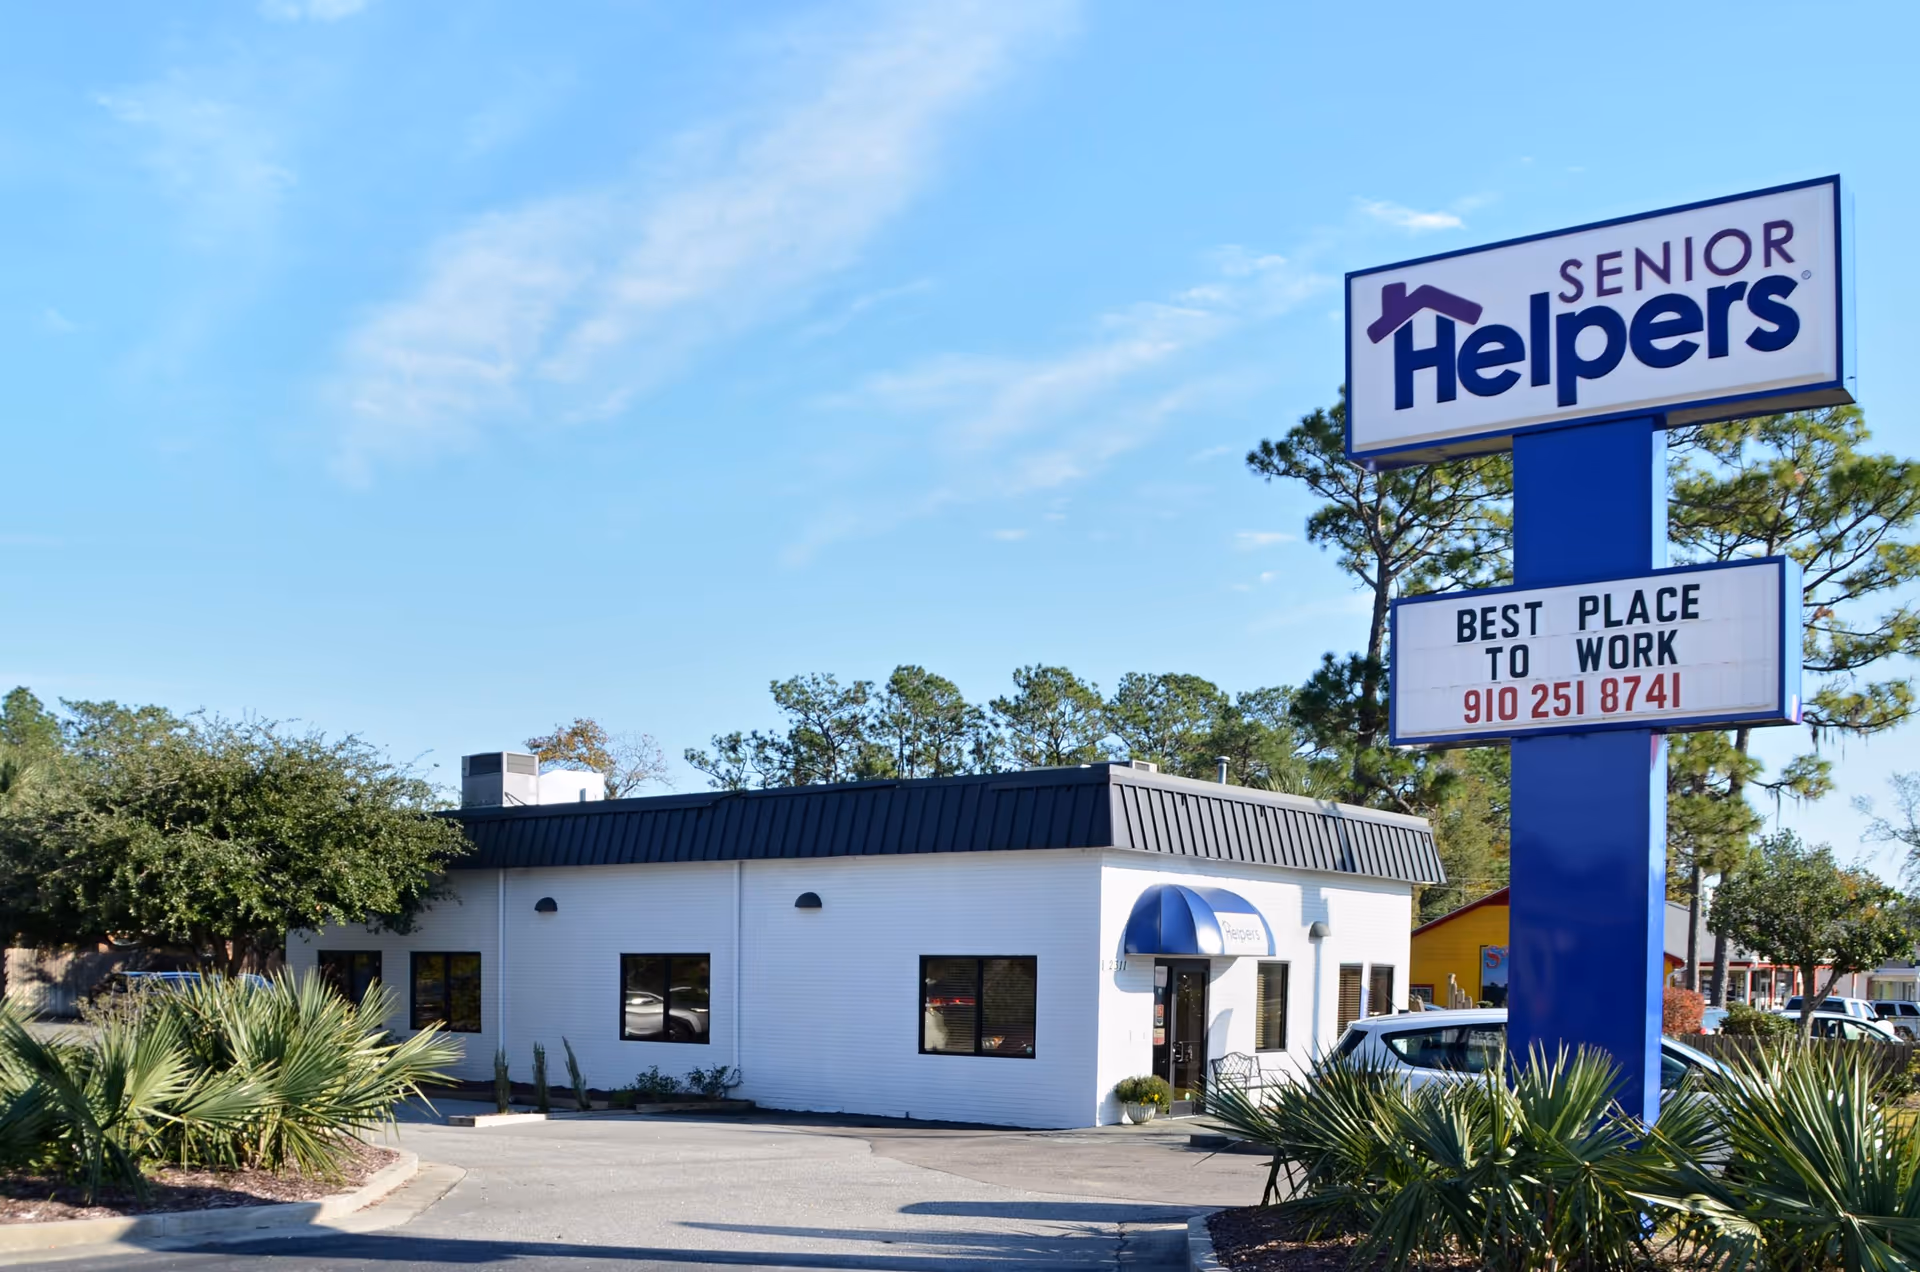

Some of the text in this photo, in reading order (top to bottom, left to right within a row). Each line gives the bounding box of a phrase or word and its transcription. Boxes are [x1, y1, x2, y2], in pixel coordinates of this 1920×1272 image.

[1558, 220, 1795, 303] SENIOR
[1393, 275, 1801, 408] Helpers
[1457, 584, 1701, 644] BEST PLACE
[1486, 630, 1678, 681] TO WORK
[1464, 673, 1681, 724] 910 251 8741
